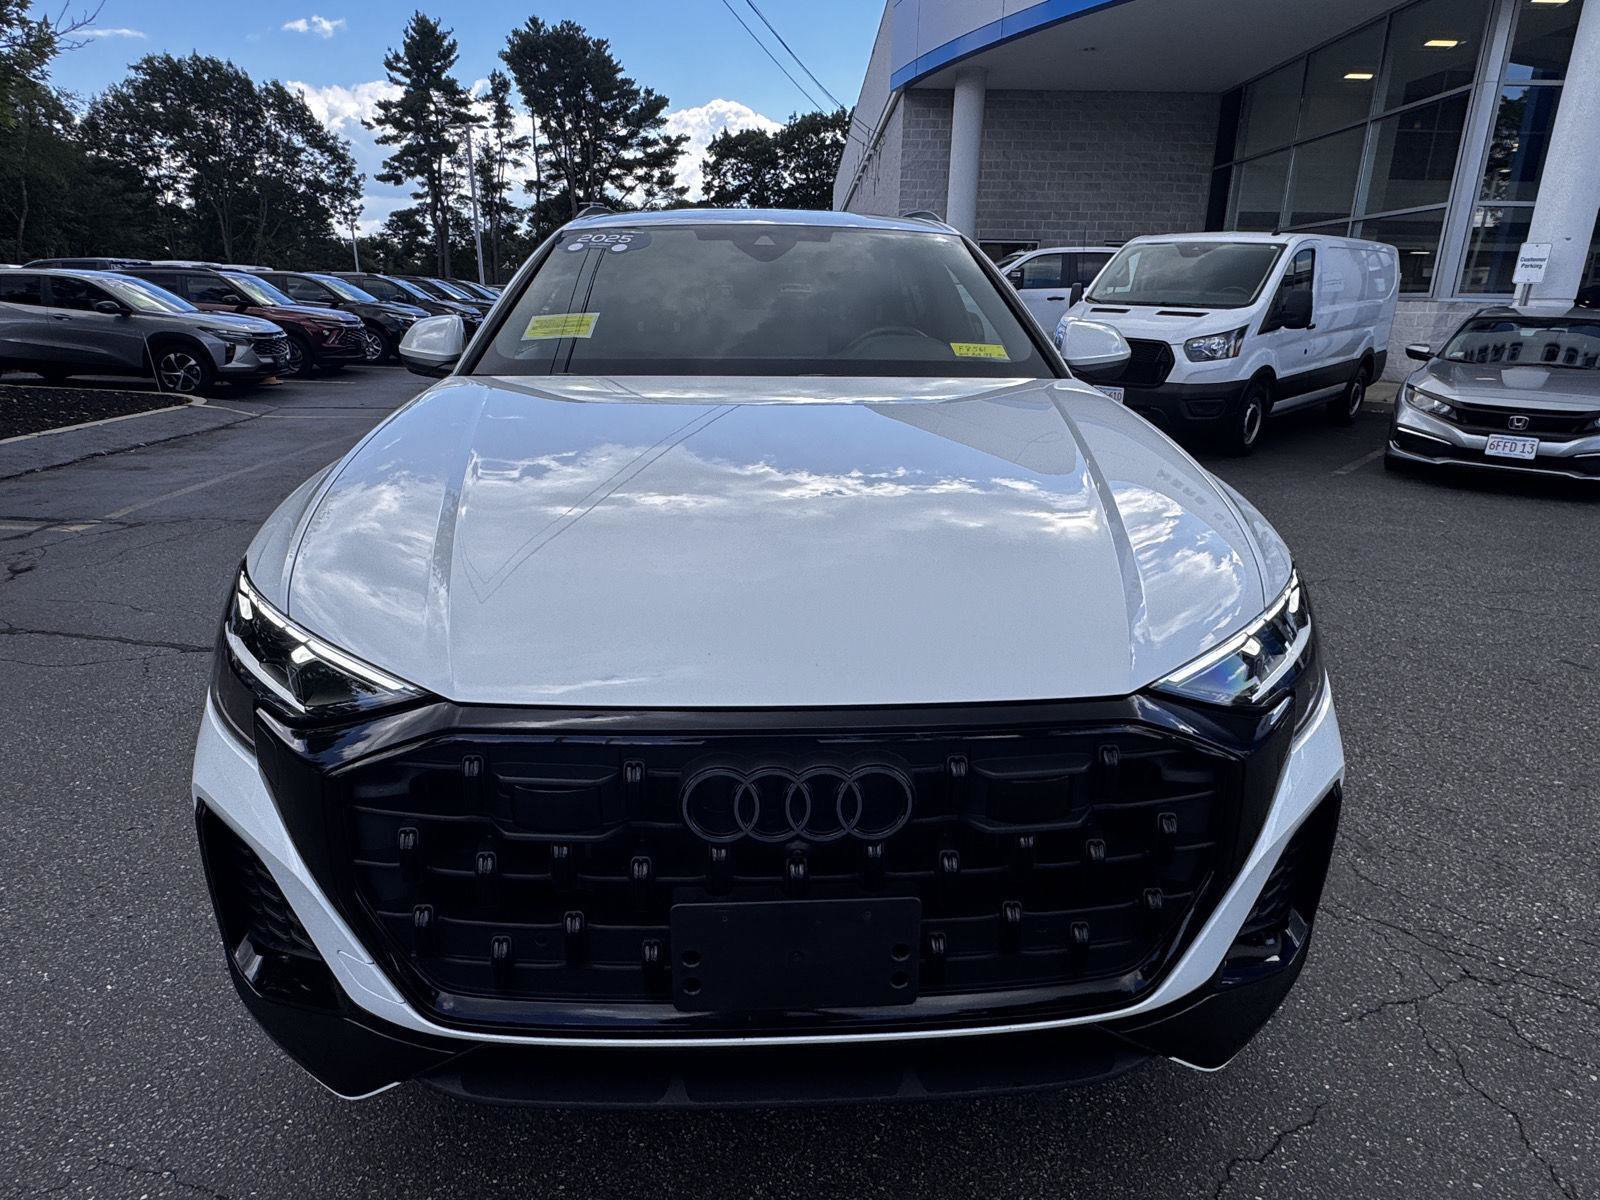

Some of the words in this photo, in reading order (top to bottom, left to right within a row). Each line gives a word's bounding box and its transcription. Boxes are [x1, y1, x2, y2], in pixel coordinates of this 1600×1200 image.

[576, 234, 634, 243] 2025
[1488, 440, 1518, 453] 6FFD
[1519, 443, 1536, 455] 13
